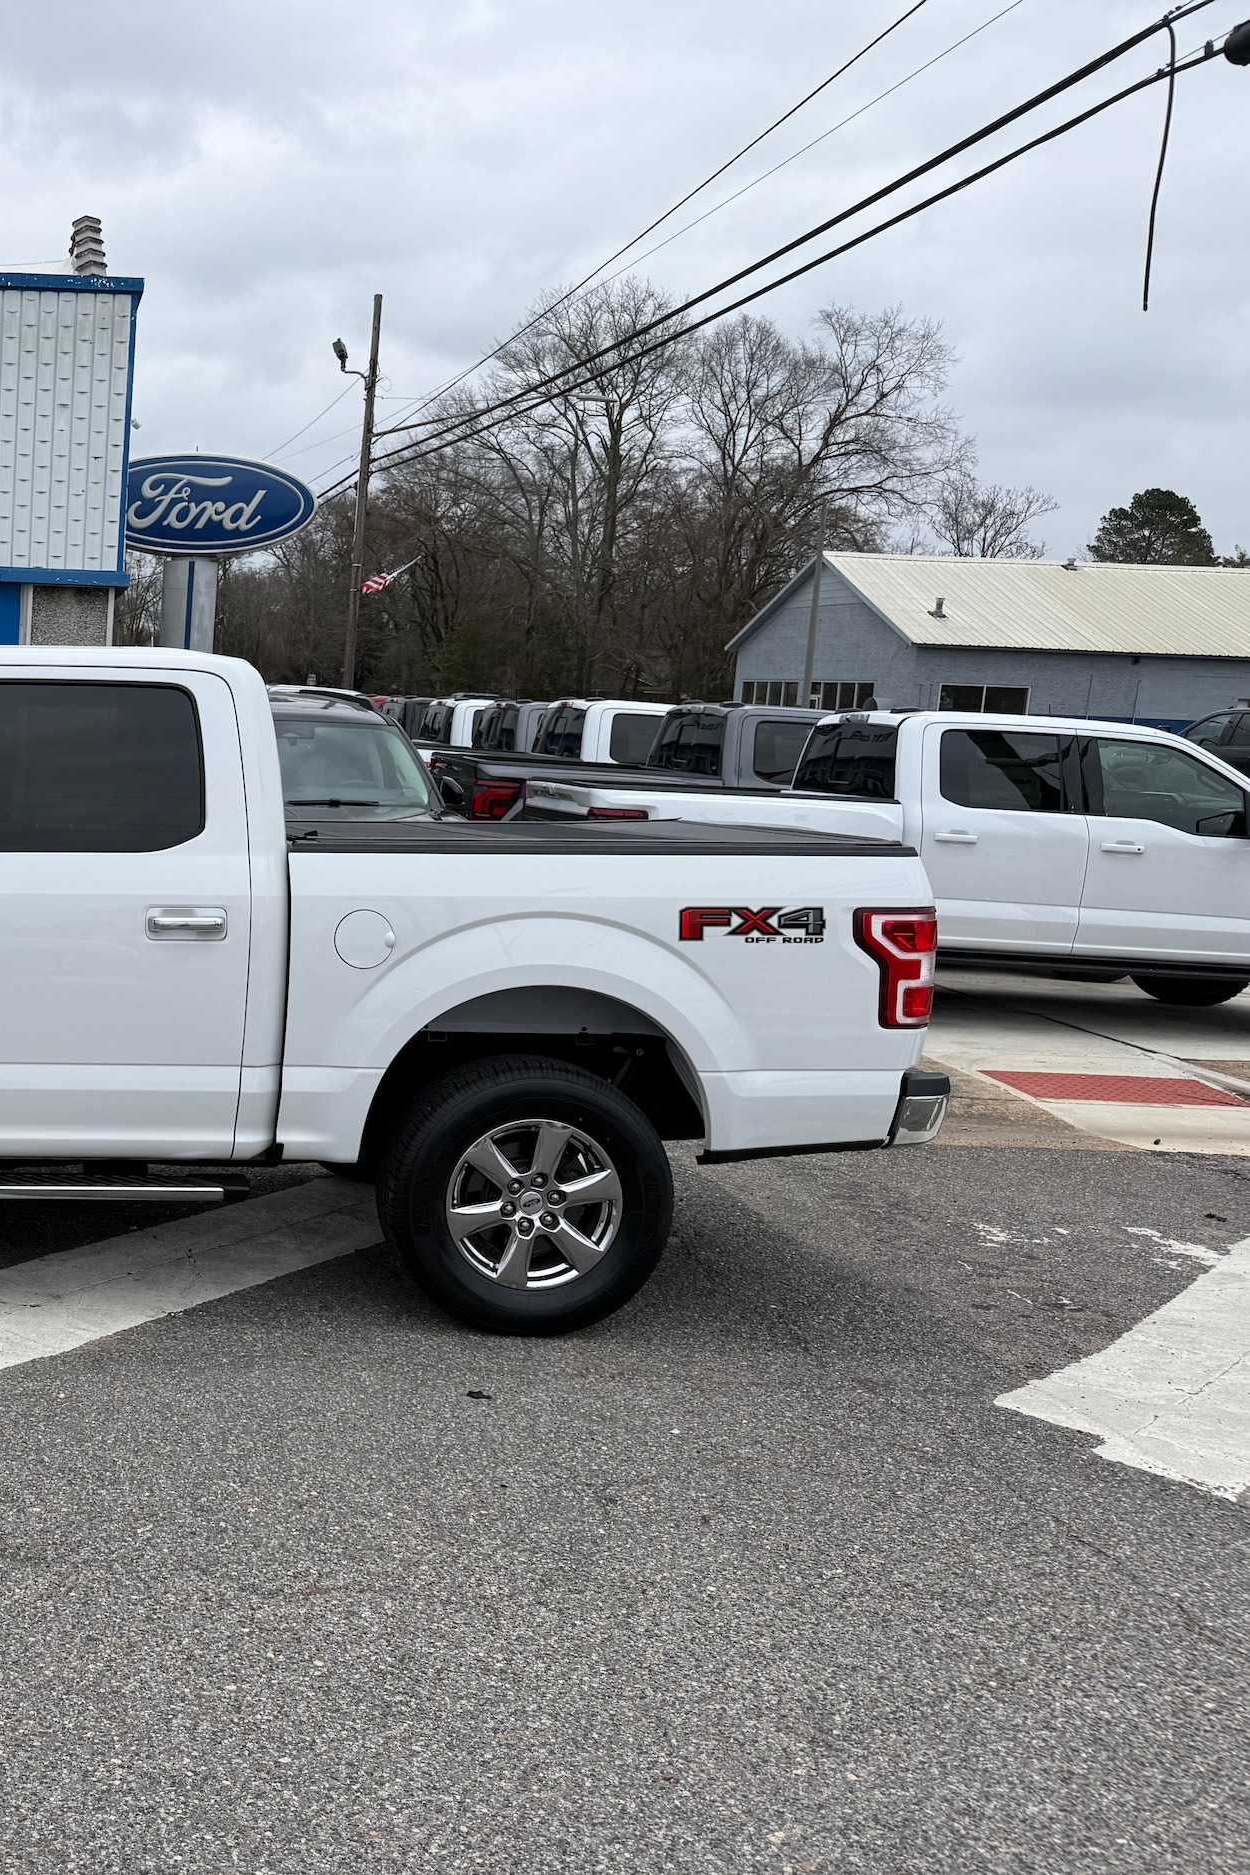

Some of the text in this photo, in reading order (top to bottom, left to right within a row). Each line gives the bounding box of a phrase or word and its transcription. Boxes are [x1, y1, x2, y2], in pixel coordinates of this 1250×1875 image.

[127, 473, 267, 532] Ford
[678, 906, 826, 941] FX4
[745, 936, 776, 944] OFF
